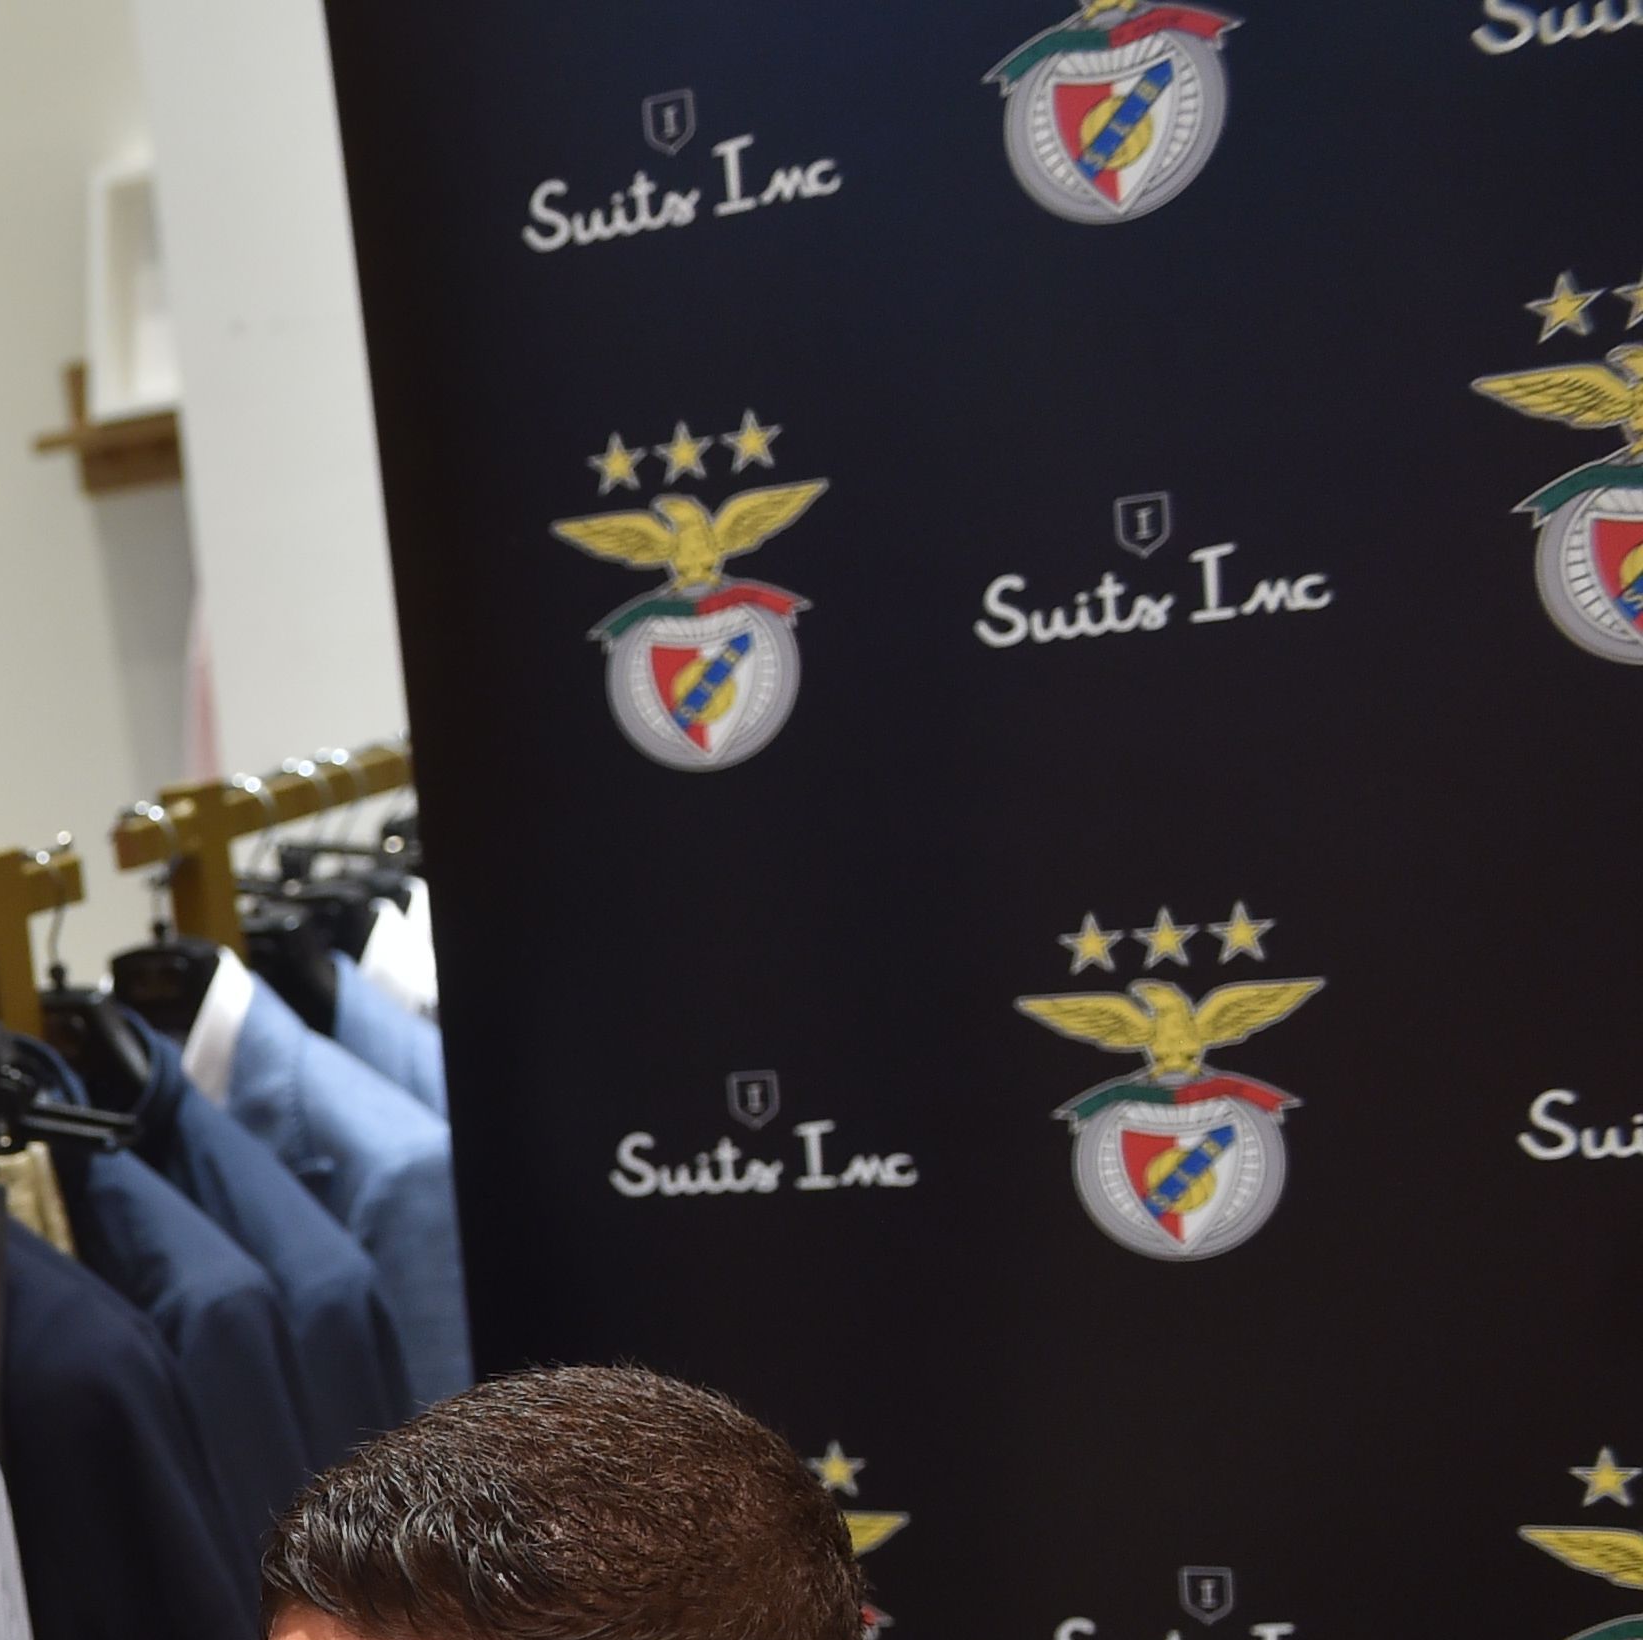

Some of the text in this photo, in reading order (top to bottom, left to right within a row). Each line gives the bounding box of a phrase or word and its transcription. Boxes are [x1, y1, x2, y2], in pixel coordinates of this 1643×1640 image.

[523, 135, 842, 252] Suits Inc
[974, 542, 1332, 648] Suits Inc
[611, 1120, 918, 1197] Suits Inc
